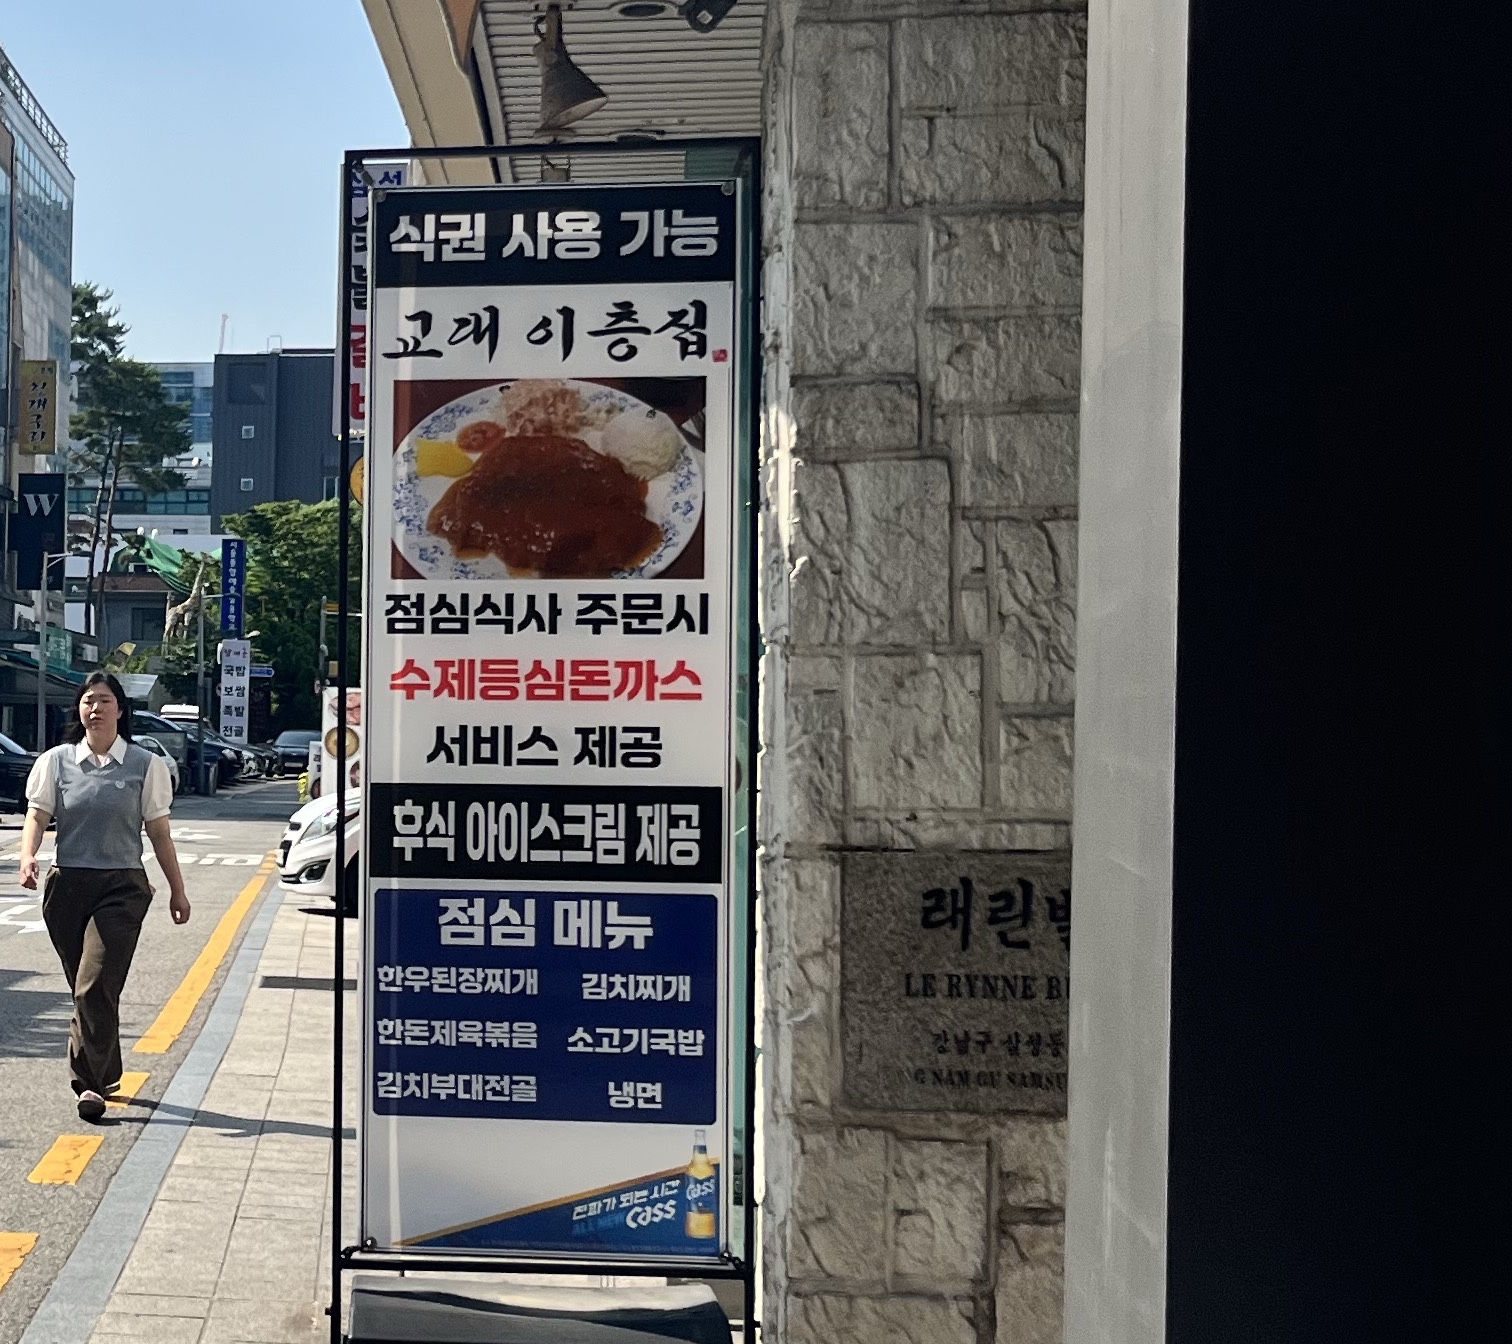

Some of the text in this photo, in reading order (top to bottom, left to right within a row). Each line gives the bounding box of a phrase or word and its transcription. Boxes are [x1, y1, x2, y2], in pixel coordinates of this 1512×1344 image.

[388, 212, 486, 262] 식권
[502, 211, 603, 260] 사용
[619, 209, 719, 258] 가능
[382, 304, 500, 364] 교대
[23, 493, 59, 517] W
[385, 593, 710, 636] 점심식사 주문시
[224, 665, 246, 677] 국밥
[390, 658, 703, 702] 수제등심돈까스
[223, 686, 245, 698] 보쌈
[223, 705, 245, 717] 족발
[223, 725, 244, 737] 전골
[426, 724, 663, 769] 서비스 제공
[392, 799, 701, 866] 후식 아이스크림 제공
[438, 897, 654, 951] 점심 메뉴
[377, 964, 692, 1003] 한우된장찌개 김치찌개
[905, 973, 937, 998] LE
[377, 1017, 704, 1057] 한돈제육볶음 소고기국밥
[377, 1071, 663, 1110] 김치부대전골 냉면
